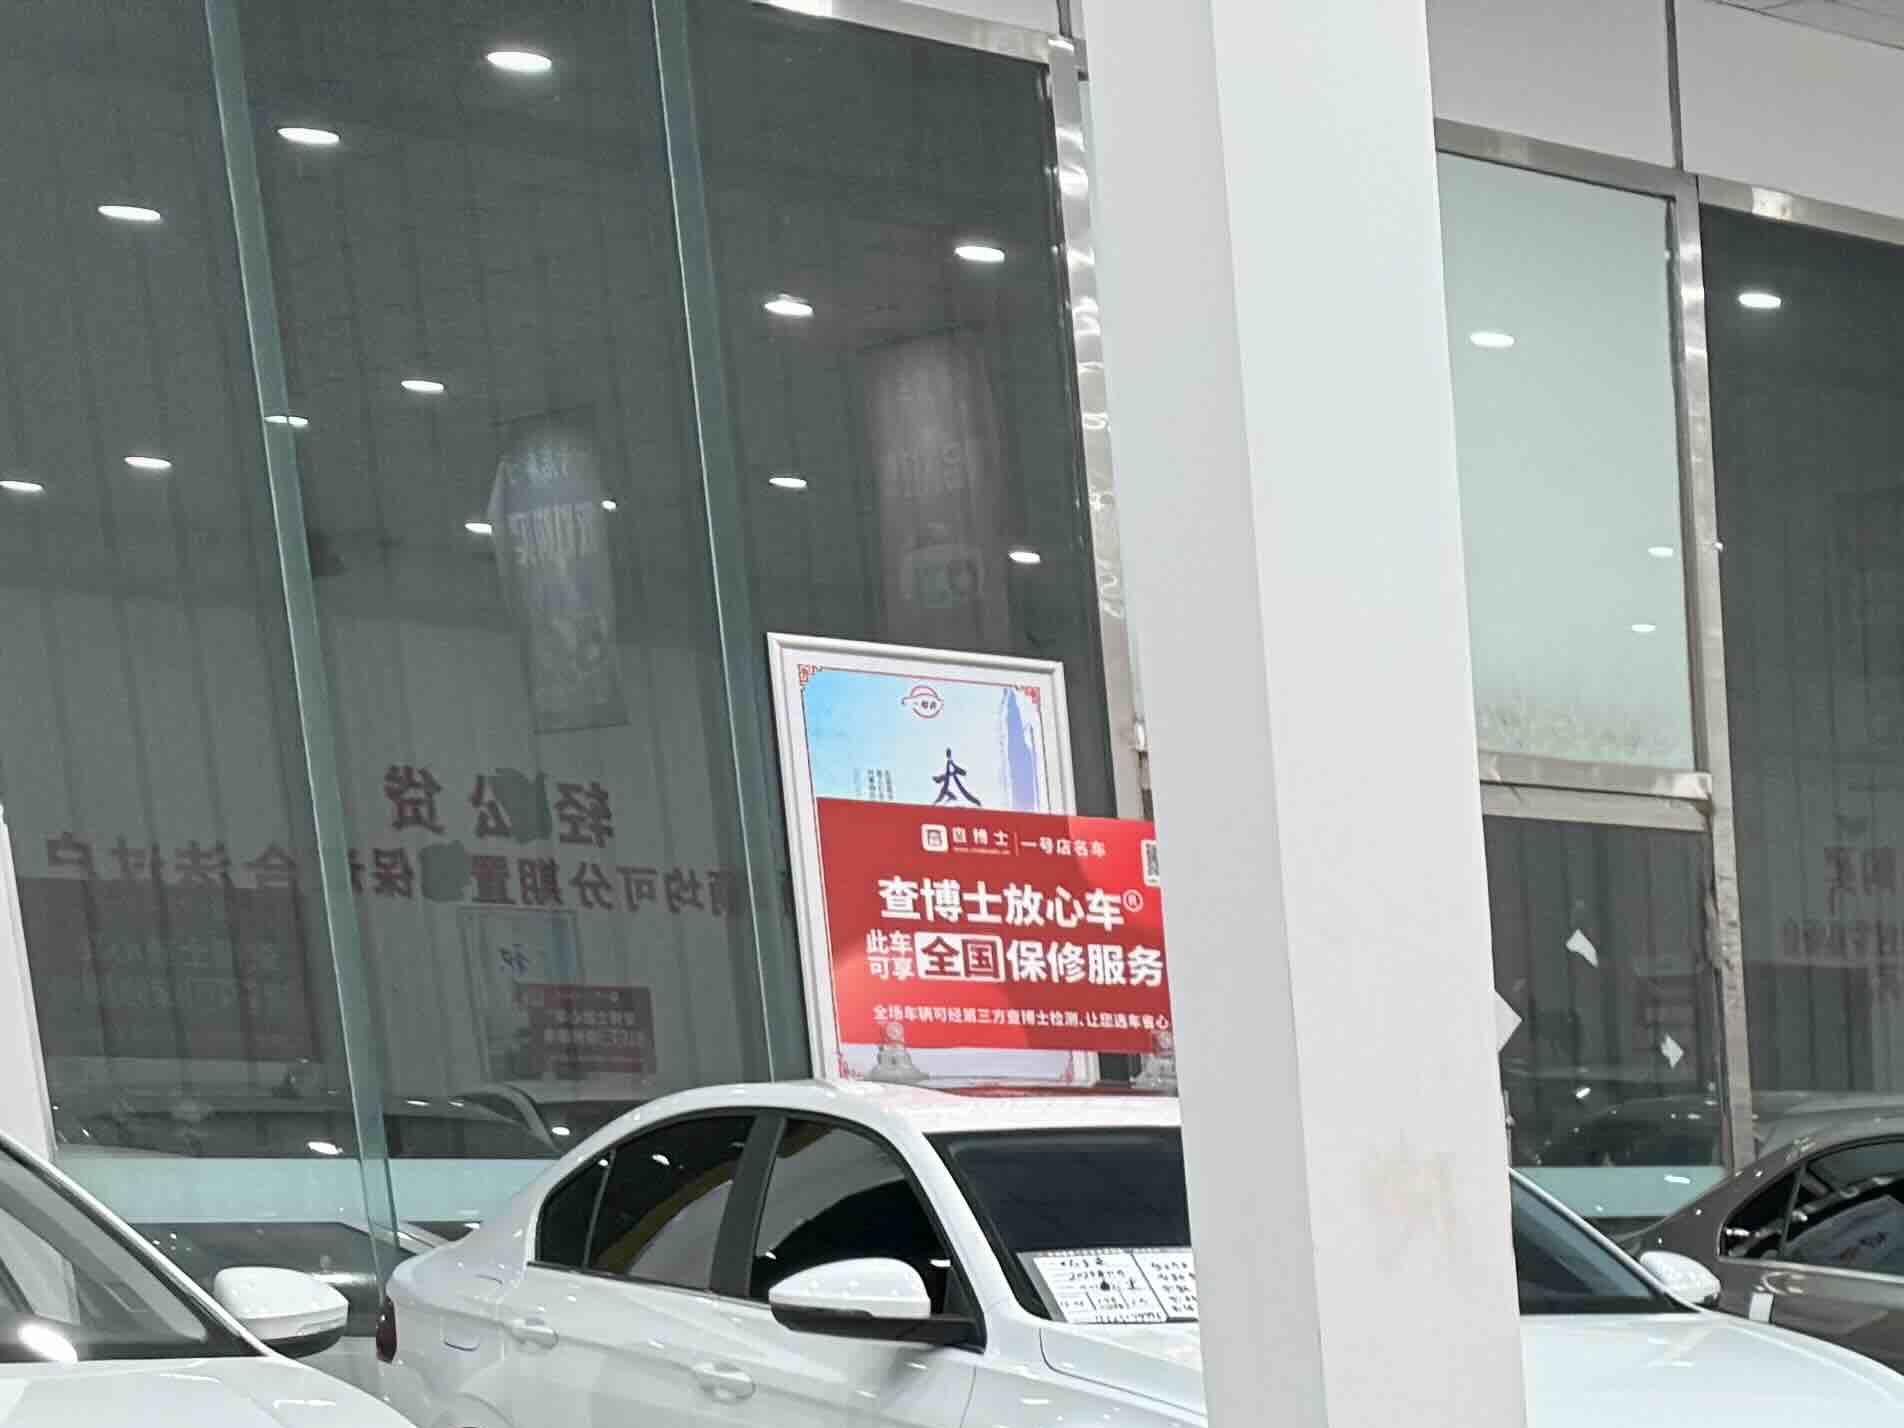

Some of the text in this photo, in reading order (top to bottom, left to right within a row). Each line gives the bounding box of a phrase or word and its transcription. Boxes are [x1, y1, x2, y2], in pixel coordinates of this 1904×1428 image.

[921, 933, 1165, 988] 全国保修服务
